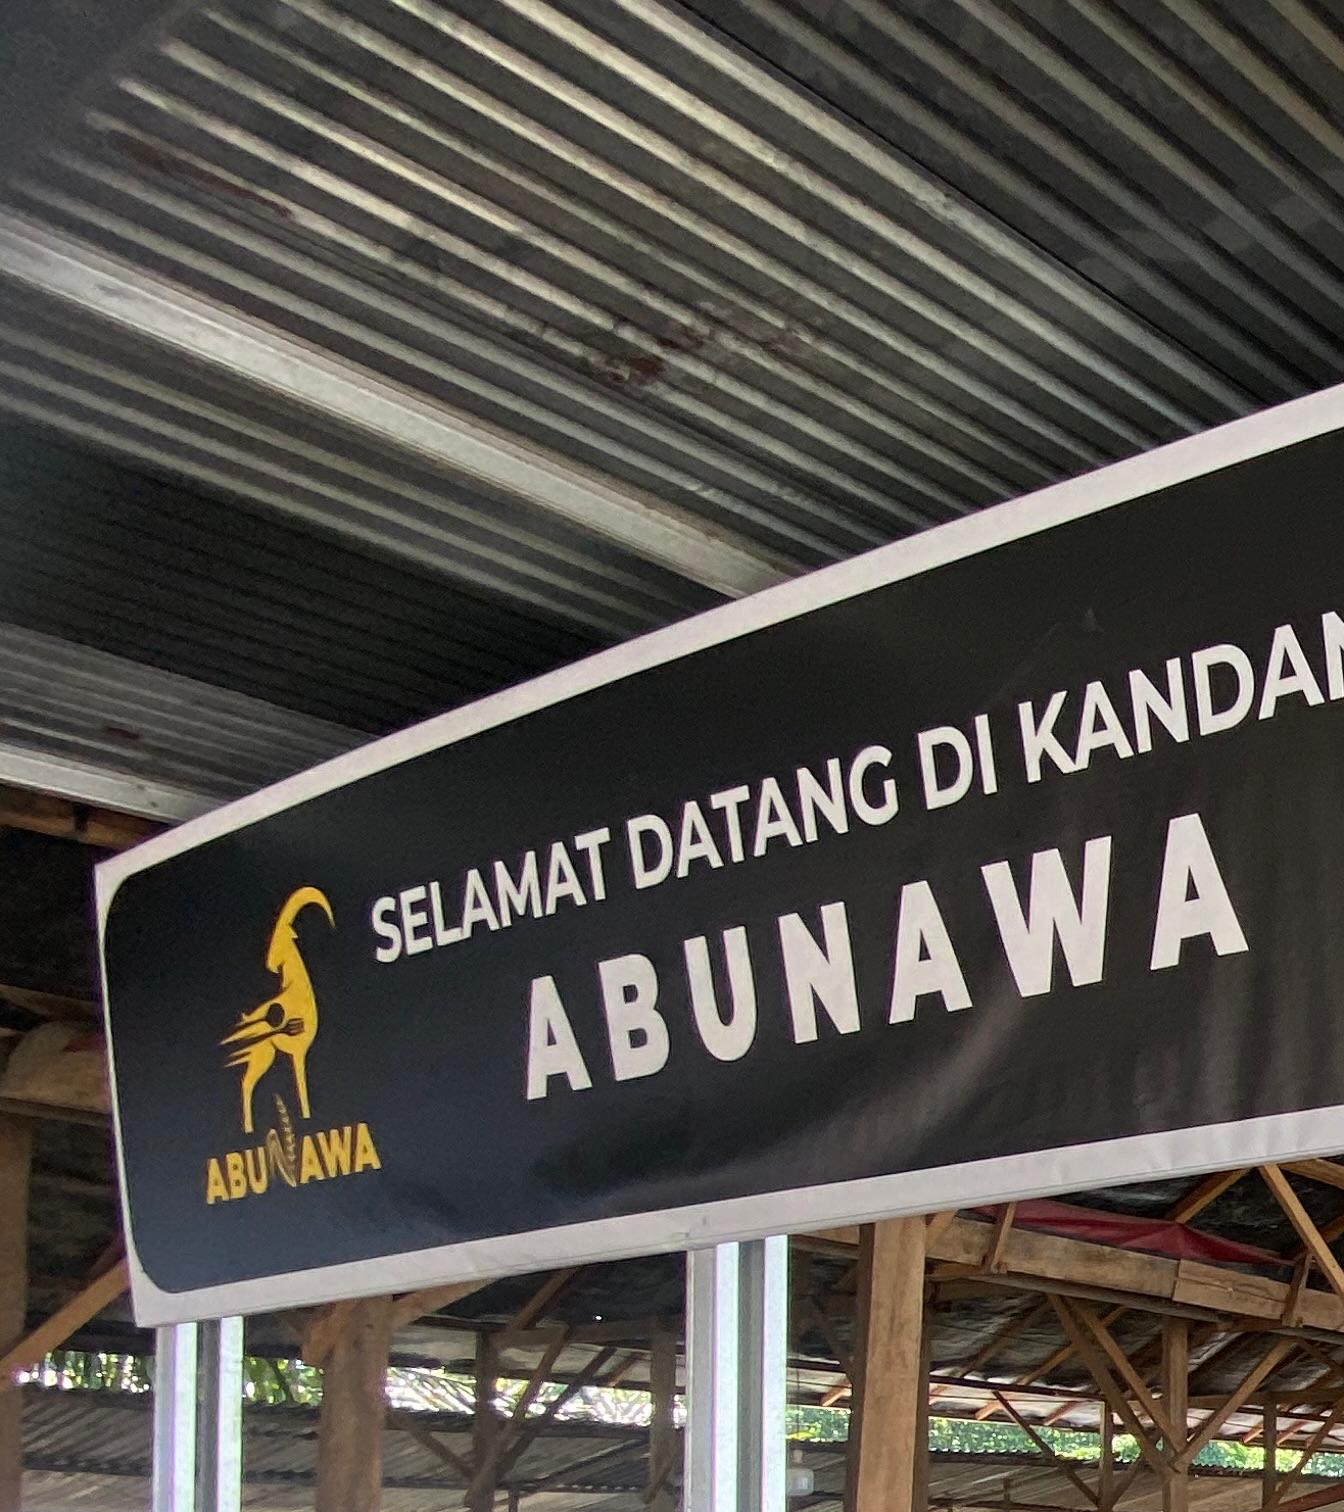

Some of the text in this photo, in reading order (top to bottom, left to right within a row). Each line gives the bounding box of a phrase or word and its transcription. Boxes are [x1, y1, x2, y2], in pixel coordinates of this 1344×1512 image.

[370, 827, 612, 964] SELAMAT
[626, 745, 900, 891] DATANG
[917, 713, 999, 811] DI
[525, 812, 1251, 1101] ABUNAWA
[206, 1094, 382, 1205] ABUNAWA
